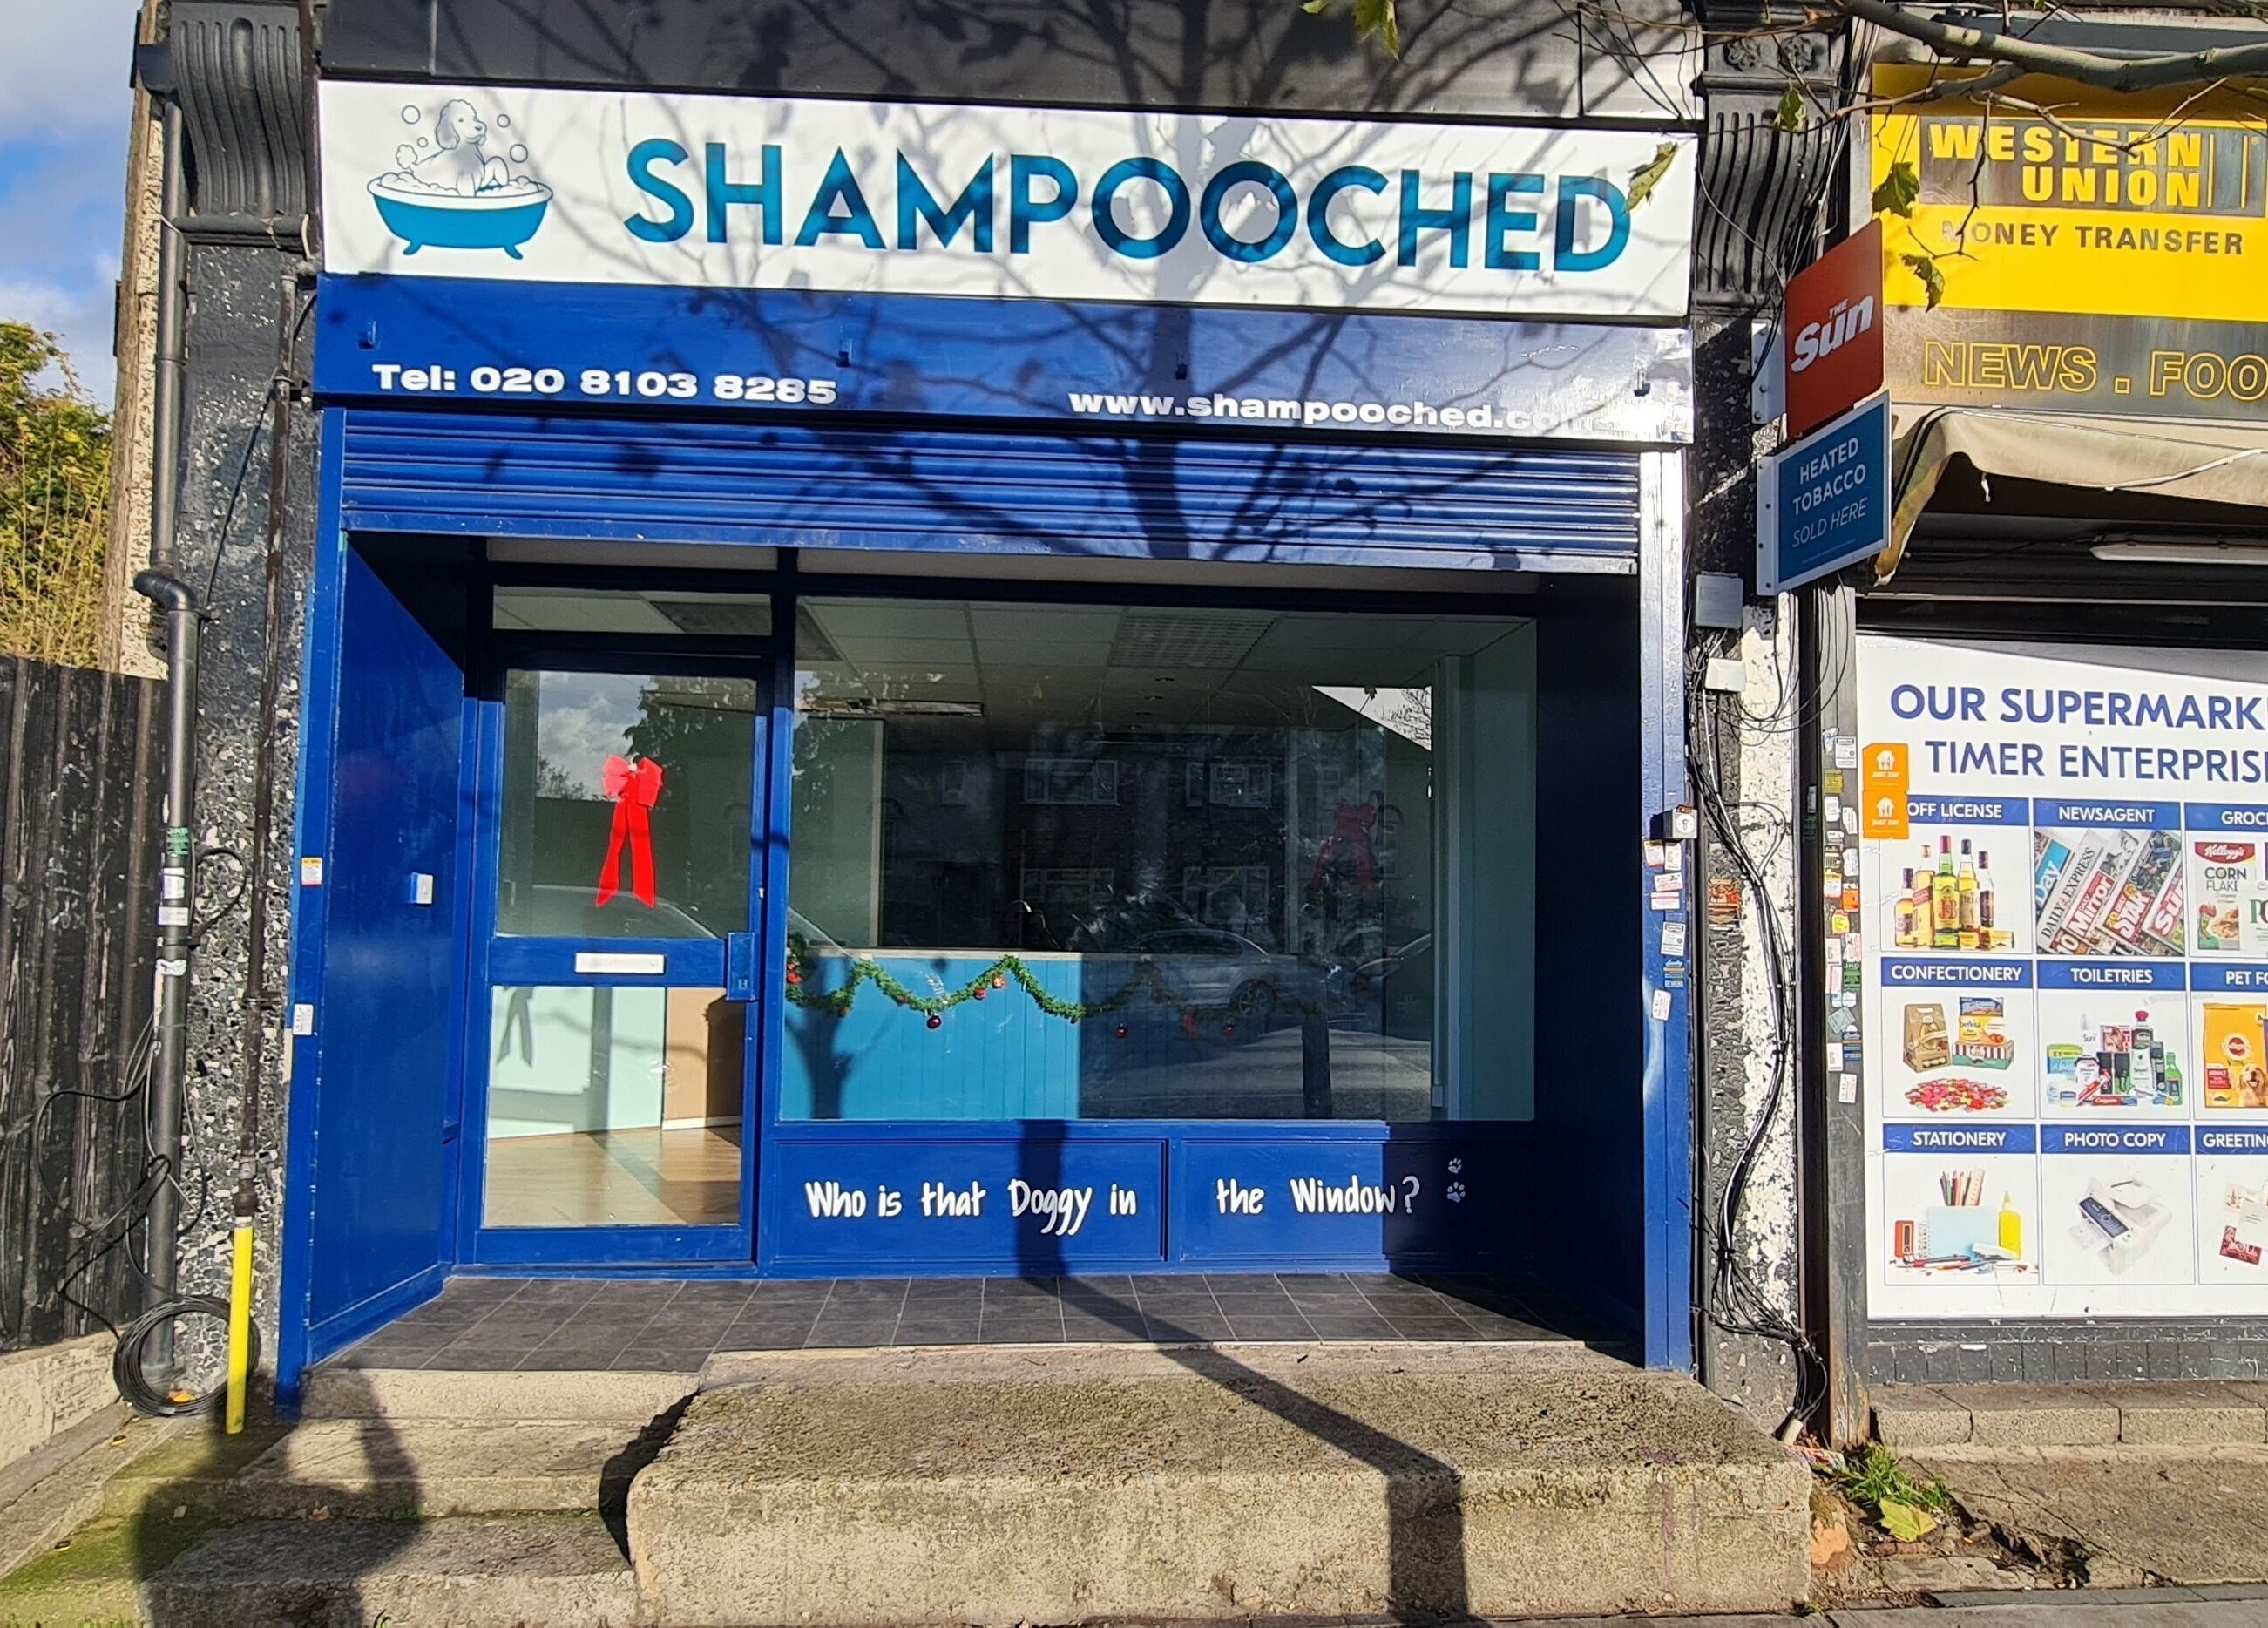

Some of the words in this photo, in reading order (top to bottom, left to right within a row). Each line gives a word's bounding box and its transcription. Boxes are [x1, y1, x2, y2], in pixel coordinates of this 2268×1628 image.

[1929, 124, 2202, 167] WESTERN
[624, 138, 1631, 273] SHAMPOOCHED
[2022, 166, 2202, 207] UNION
[1942, 220, 2059, 247] MONEY
[2075, 225, 2244, 255] TRANSFER
[1791, 295, 1873, 372] Sun
[372, 363, 456, 391] Tel:
[471, 366, 565, 394] 020
[580, 370, 698, 398] 8103
[714, 373, 838, 404] 8285
[1924, 341, 2097, 393] NEWS
[1068, 390, 1596, 432] www.shampooched.co
[1799, 437, 1859, 485] HEATED
[1792, 463, 1866, 516] TOBACCO
[1791, 518, 1827, 547] SOLD
[1830, 497, 1868, 531] HERE
[1890, 684, 1987, 721] OUR
[2000, 688, 2268, 731] SUPERMARK
[1925, 740, 2045, 777] TIMER
[1907, 802, 1937, 817] OFF
[1940, 803, 2002, 818] LICENSE
[2059, 807, 2155, 823] NEWSAGENT
[2221, 811, 2268, 826] GROC
[2041, 900, 2065, 939] DAILY
[2062, 847, 2095, 900] EXPRESS
[2204, 867, 2247, 880] CORN
[2068, 877, 2112, 937] Mirror
[1892, 965, 2021, 981] CONFECTIONERY
[2070, 967, 2153, 983] TOILETRIES
[2226, 970, 2252, 985] PET
[1913, 1132, 2006, 1147] STATIONERY
[2064, 1133, 2119, 1148] PHOTO
[2123, 1133, 2166, 1148] COPY
[2203, 1133, 2268, 1148] GREETIN
[805, 1182, 865, 1218] Who
[878, 1184, 903, 1217] is
[920, 1180, 986, 1218] that
[1007, 1180, 1093, 1235] Doggy
[1110, 1184, 1138, 1216] in
[1216, 1178, 1265, 1215] the
[1290, 1176, 1420, 1214] Window?
